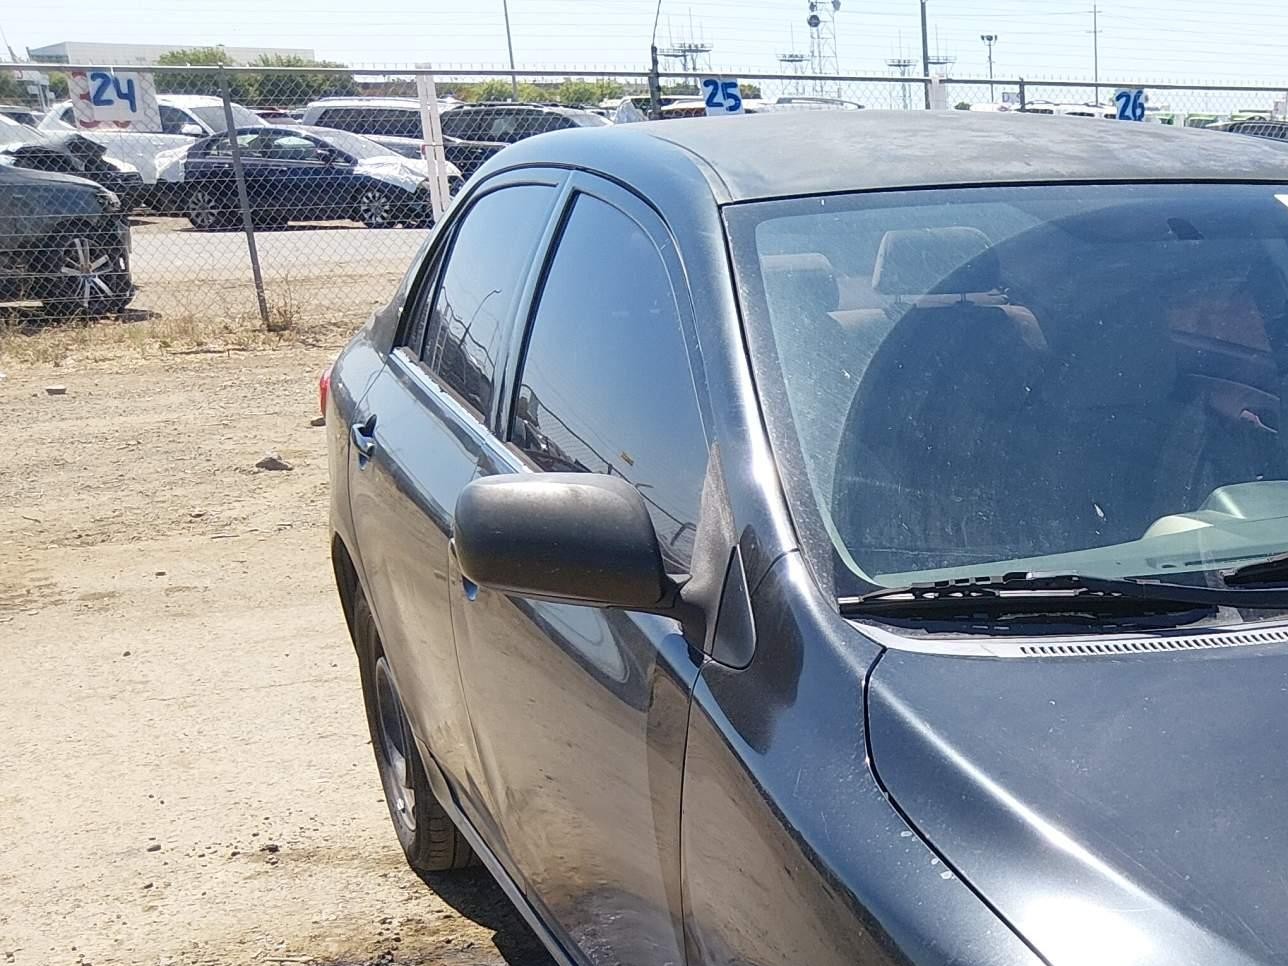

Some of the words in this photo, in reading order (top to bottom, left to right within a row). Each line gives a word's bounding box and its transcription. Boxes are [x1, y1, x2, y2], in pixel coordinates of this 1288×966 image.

[90, 72, 137, 113] 24
[703, 79, 741, 112] 25
[1115, 90, 1145, 121] 26
